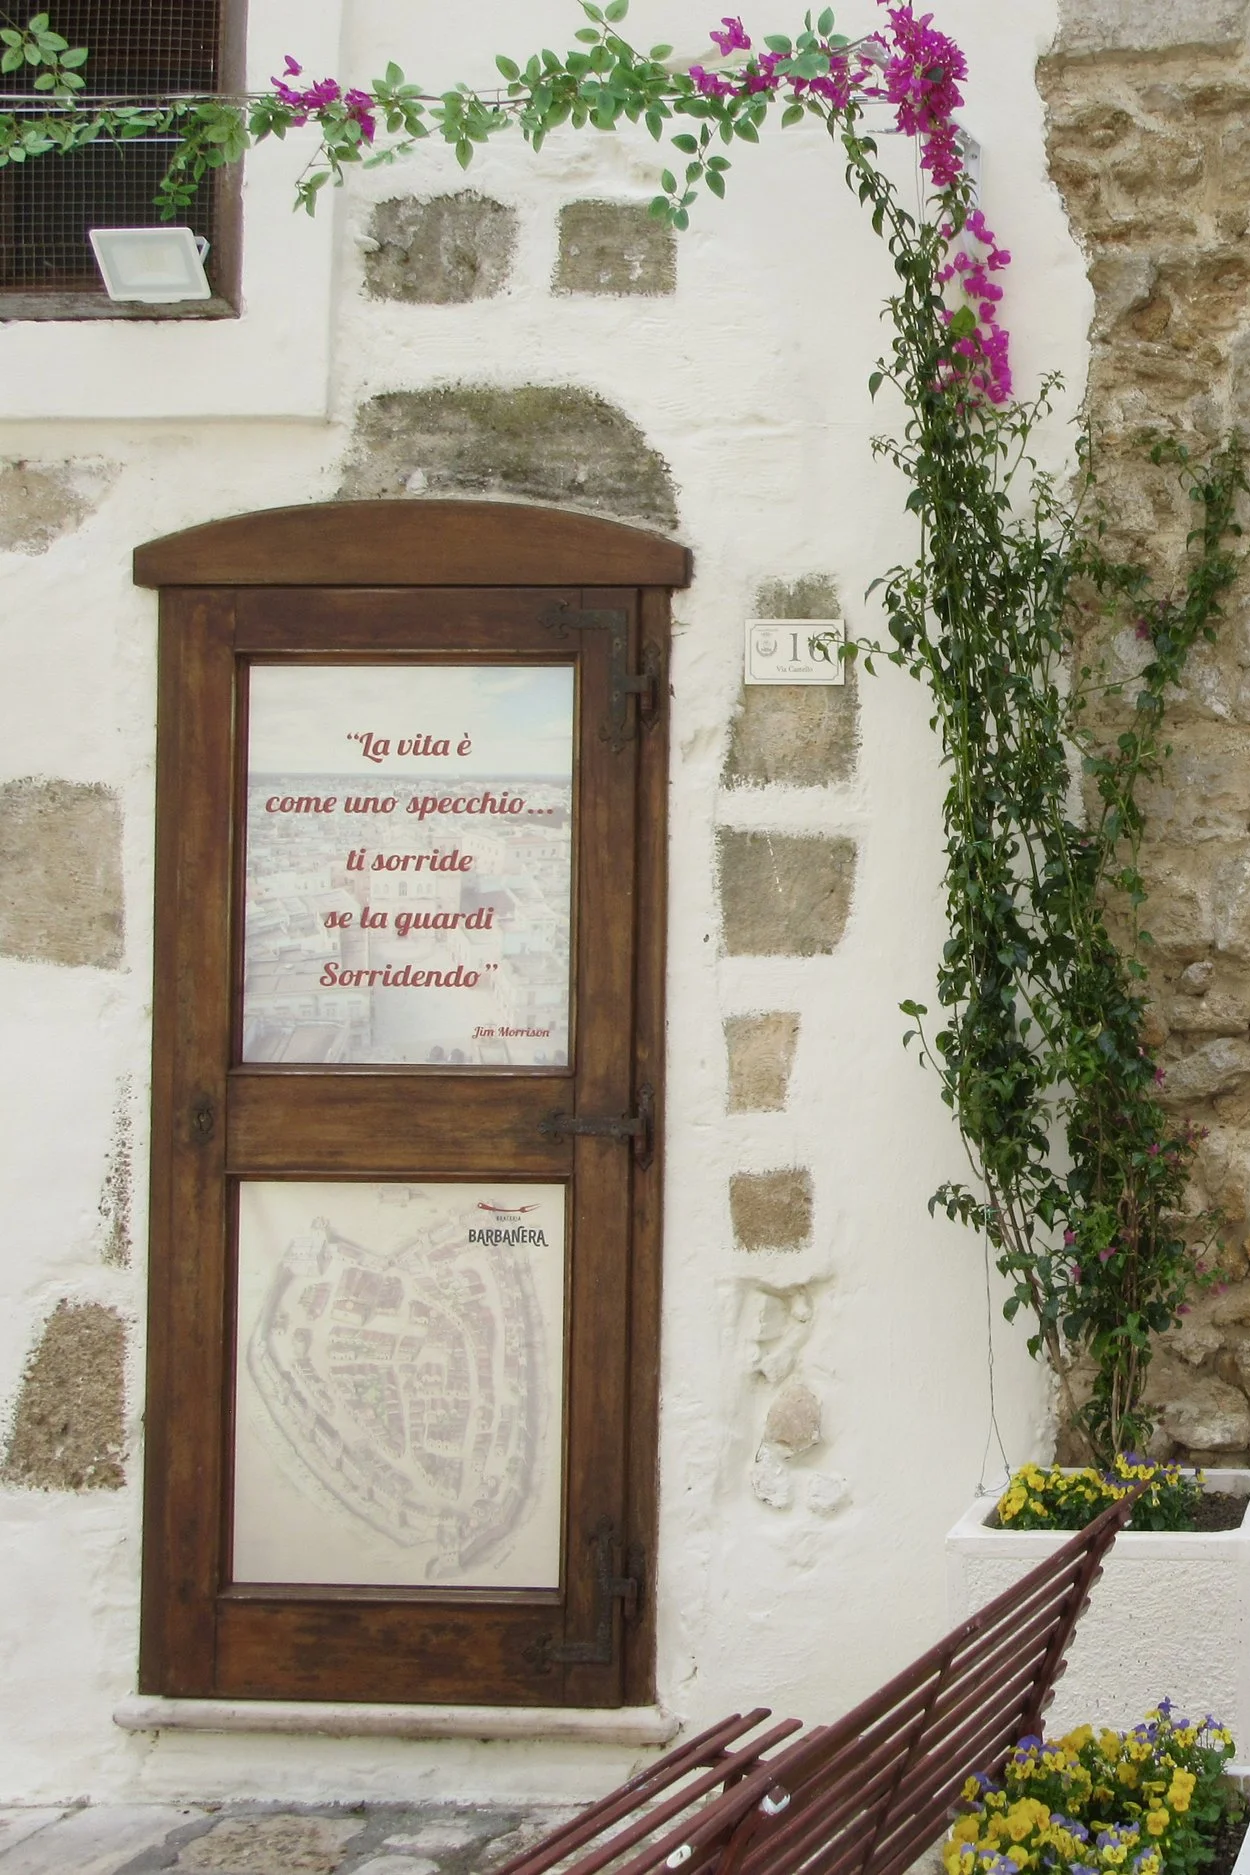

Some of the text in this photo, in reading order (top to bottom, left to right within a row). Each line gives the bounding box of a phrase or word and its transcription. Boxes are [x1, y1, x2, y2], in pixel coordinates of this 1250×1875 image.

[776, 664, 788, 673] Via
[346, 731, 472, 764] “La vita è
[265, 795, 337, 815] come
[344, 795, 398, 815] uno
[346, 847, 473, 873] ti sorride
[323, 906, 495, 937] se la guardi
[472, 1026, 550, 1039] Jim Morrison
[468, 1226, 549, 1247] BARBANERA
